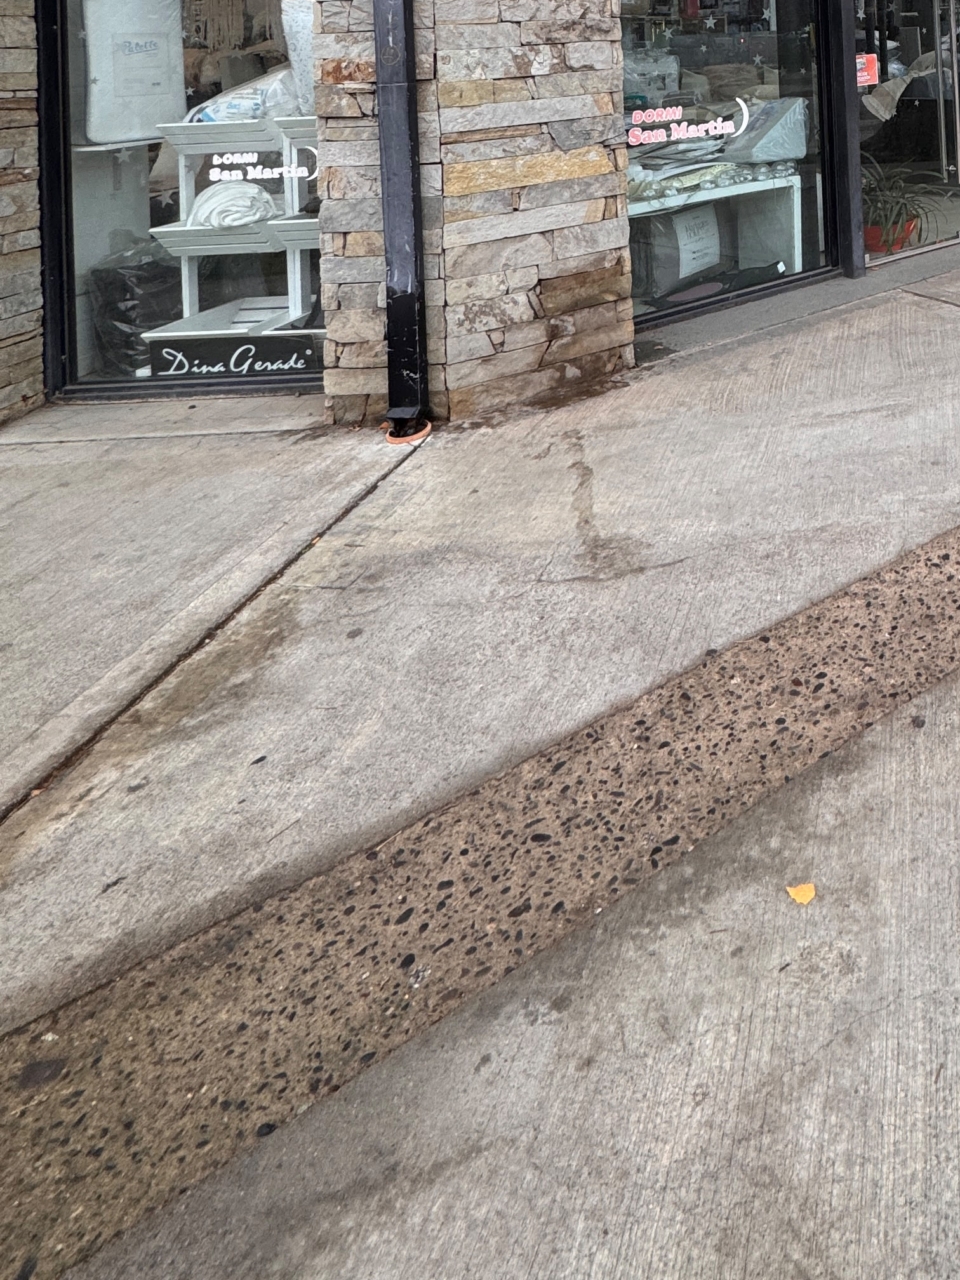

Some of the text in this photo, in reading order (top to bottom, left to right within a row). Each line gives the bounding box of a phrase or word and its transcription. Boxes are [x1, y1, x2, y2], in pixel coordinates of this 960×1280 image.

[632, 106, 683, 124] DORMI
[628, 127, 667, 146] San
[208, 167, 244, 181] San
[157, 348, 226, 375] Dina
